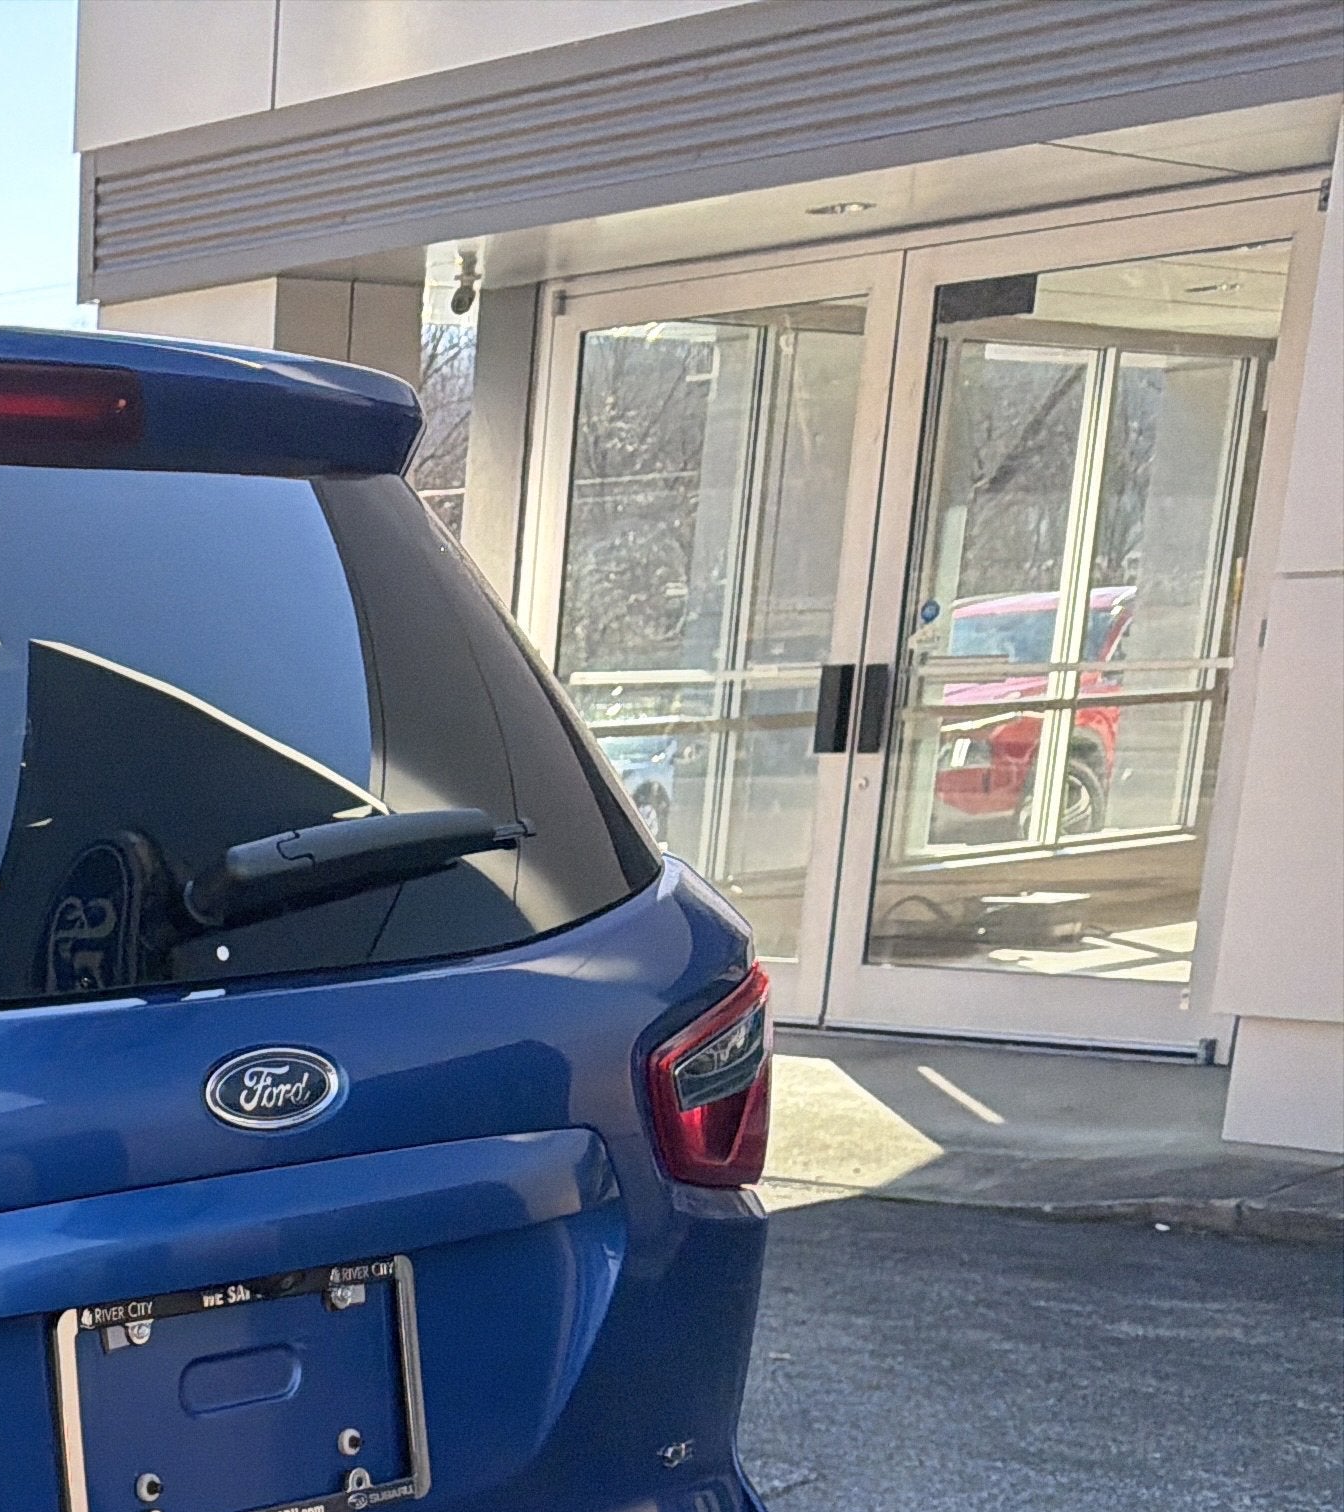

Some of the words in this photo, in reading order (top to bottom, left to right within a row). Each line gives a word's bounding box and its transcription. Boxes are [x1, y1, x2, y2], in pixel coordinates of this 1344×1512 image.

[240, 1064, 311, 1112] Ford
[342, 1265, 370, 1281] RIVER
[371, 1261, 394, 1277] CITY
[94, 1306, 124, 1325] RIVER
[127, 1300, 153, 1318] CITY
[368, 1484, 414, 1505] SUBARU
